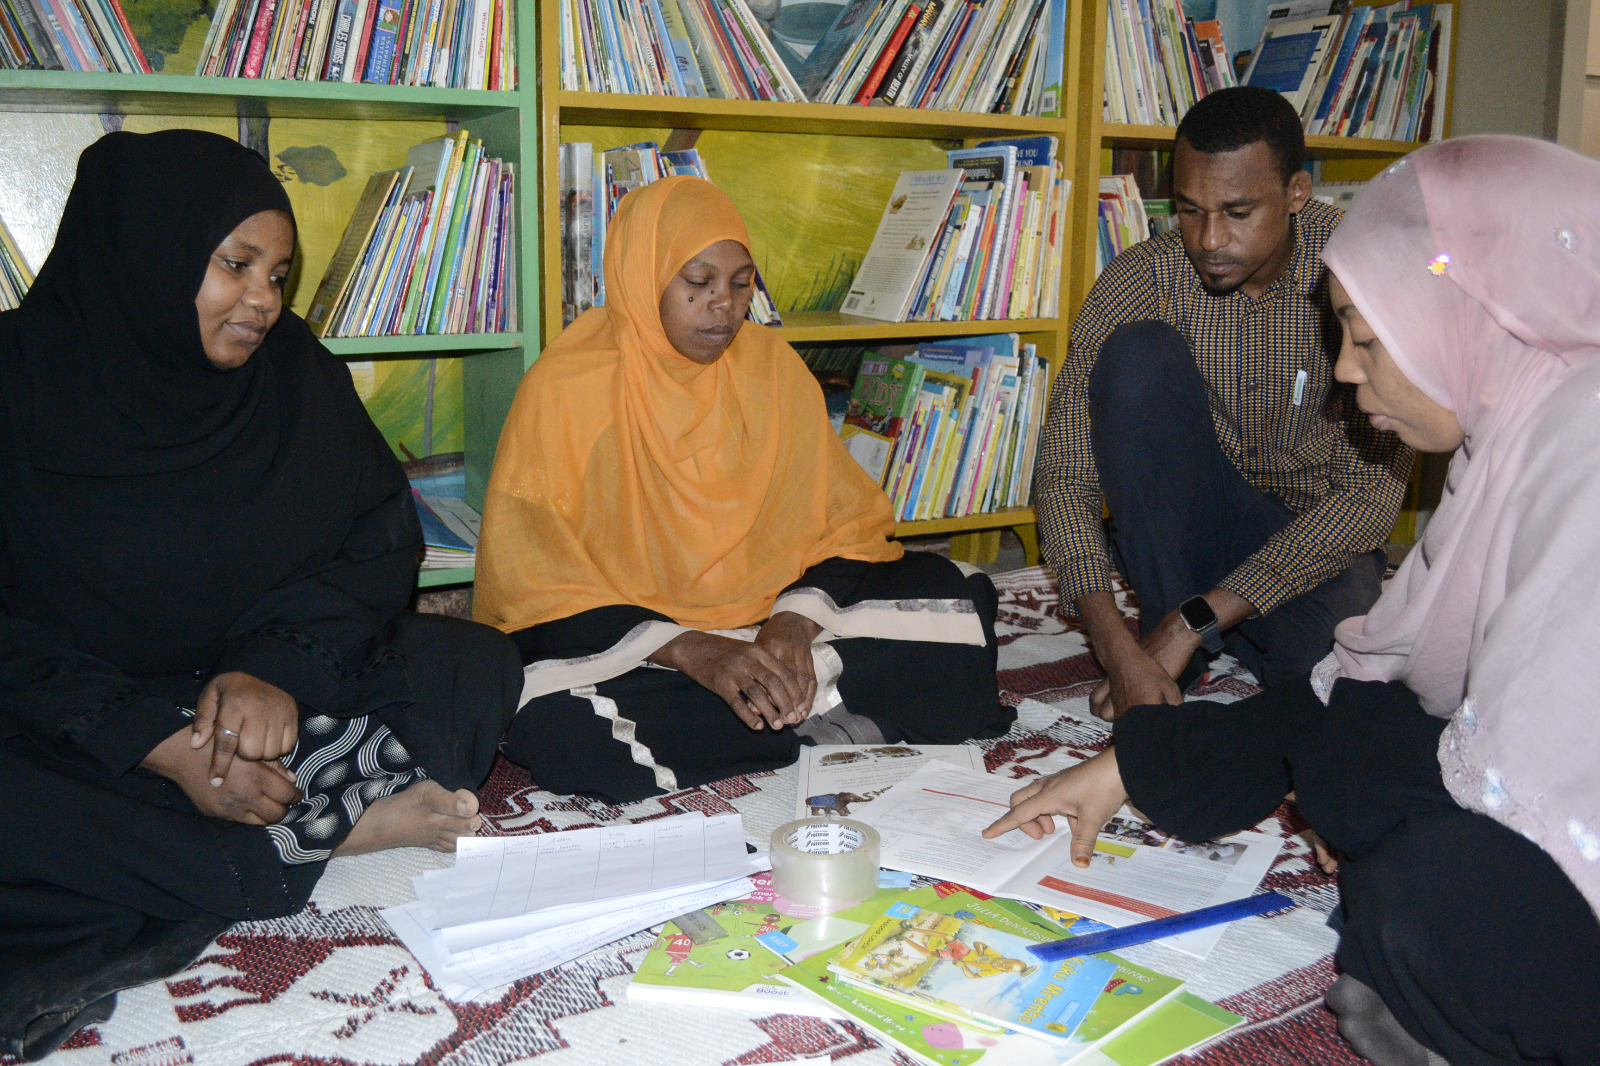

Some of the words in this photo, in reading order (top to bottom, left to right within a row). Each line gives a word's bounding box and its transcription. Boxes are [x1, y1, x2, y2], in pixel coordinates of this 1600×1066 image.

[918, 2, 938, 30] MARIANI
[336, 14, 351, 41] CHARLES
[332, 40, 346, 64] STROSS
[373, 35, 385, 79] BATTERSEA
[379, 39, 390, 78] SAPPHIRE
[477, 37, 485, 58] Teddy?
[288, 47, 298, 76] WAYLAND
[898, 52, 914, 73] VALLEY
[885, 78, 901, 98] DEATH
[1025, 149, 1039, 157] YOU
[860, 376, 903, 410] BODY
[967, 902, 1000, 919] JULIA
[759, 925, 773, 933] 20
[673, 938, 691, 946] 40
[769, 935, 789, 948] EAEP
[1053, 957, 1086, 981] Kuku
[756, 987, 789, 996] Boost
[1018, 982, 1065, 1024] Mrembo
